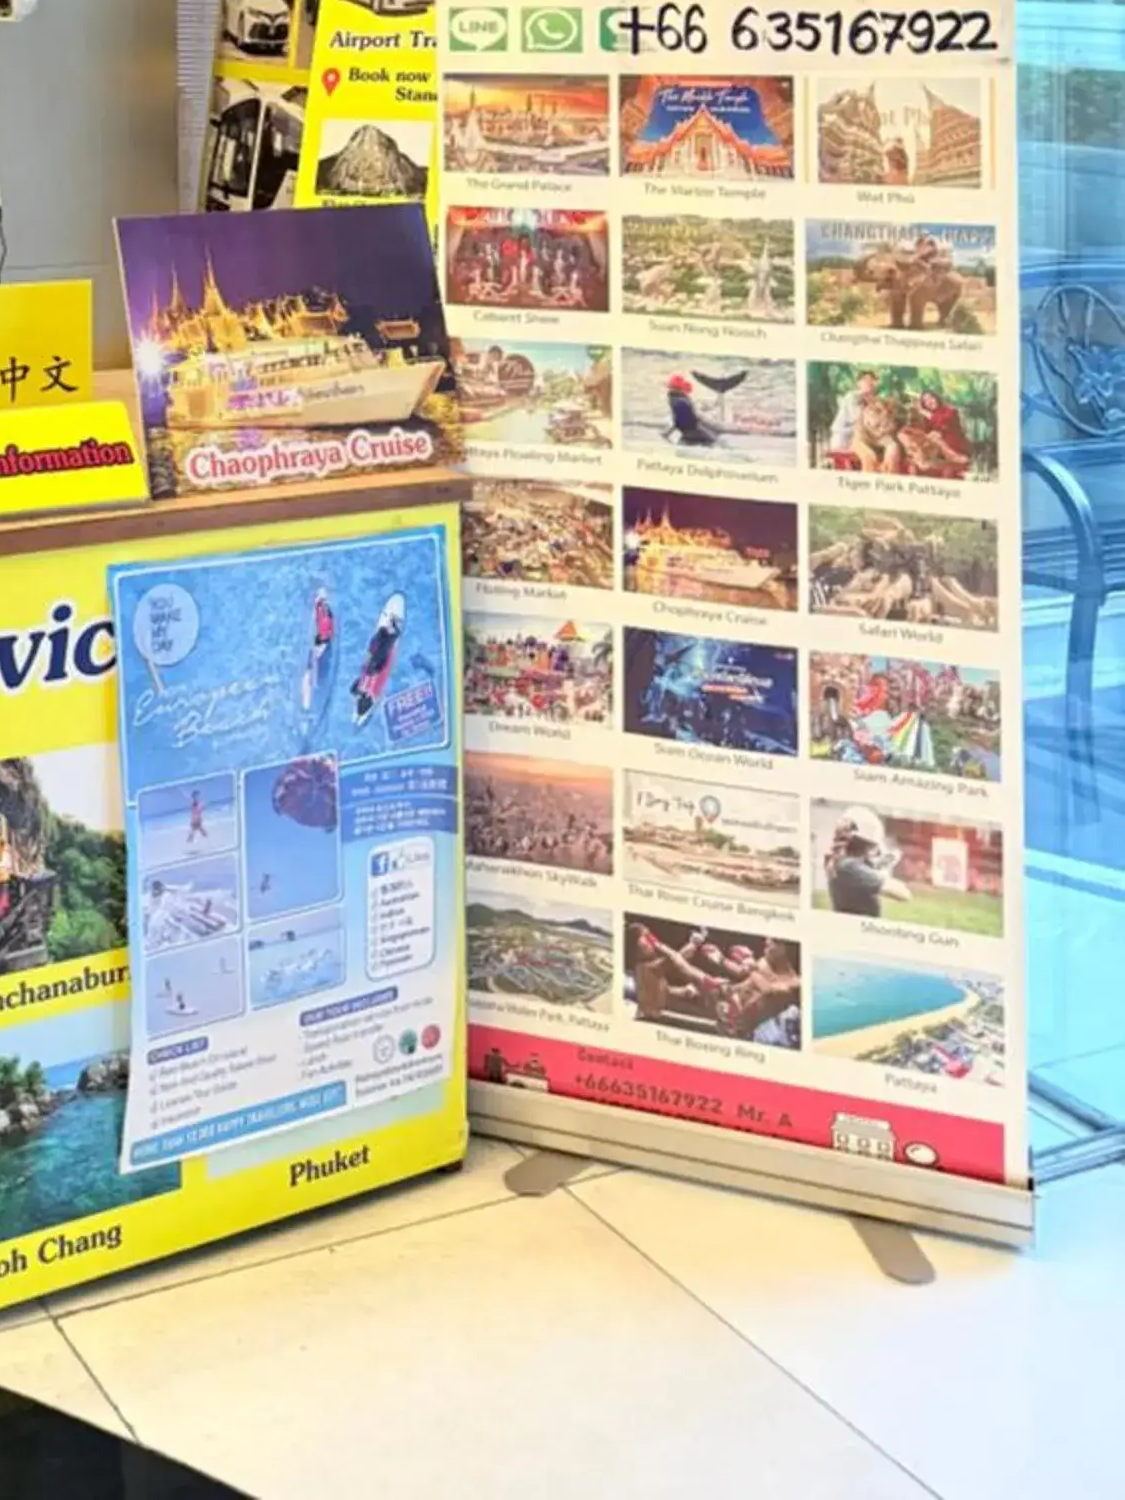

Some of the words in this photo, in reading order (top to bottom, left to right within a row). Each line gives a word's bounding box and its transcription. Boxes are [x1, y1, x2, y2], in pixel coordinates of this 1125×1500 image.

[329, 31, 401, 51] Airport
[459, 21, 499, 33] LINE
[618, 2, 708, 55] +66
[730, 6, 999, 56] 635167922
[349, 68, 390, 82] Book
[396, 71, 432, 82] now
[190, 441, 343, 480] Chaophraya
[350, 433, 429, 461] Cruise
[779, 1113, 793, 1127] A
[289, 1145, 371, 1187] Phuket
[38, 1223, 123, 1265] Chang
